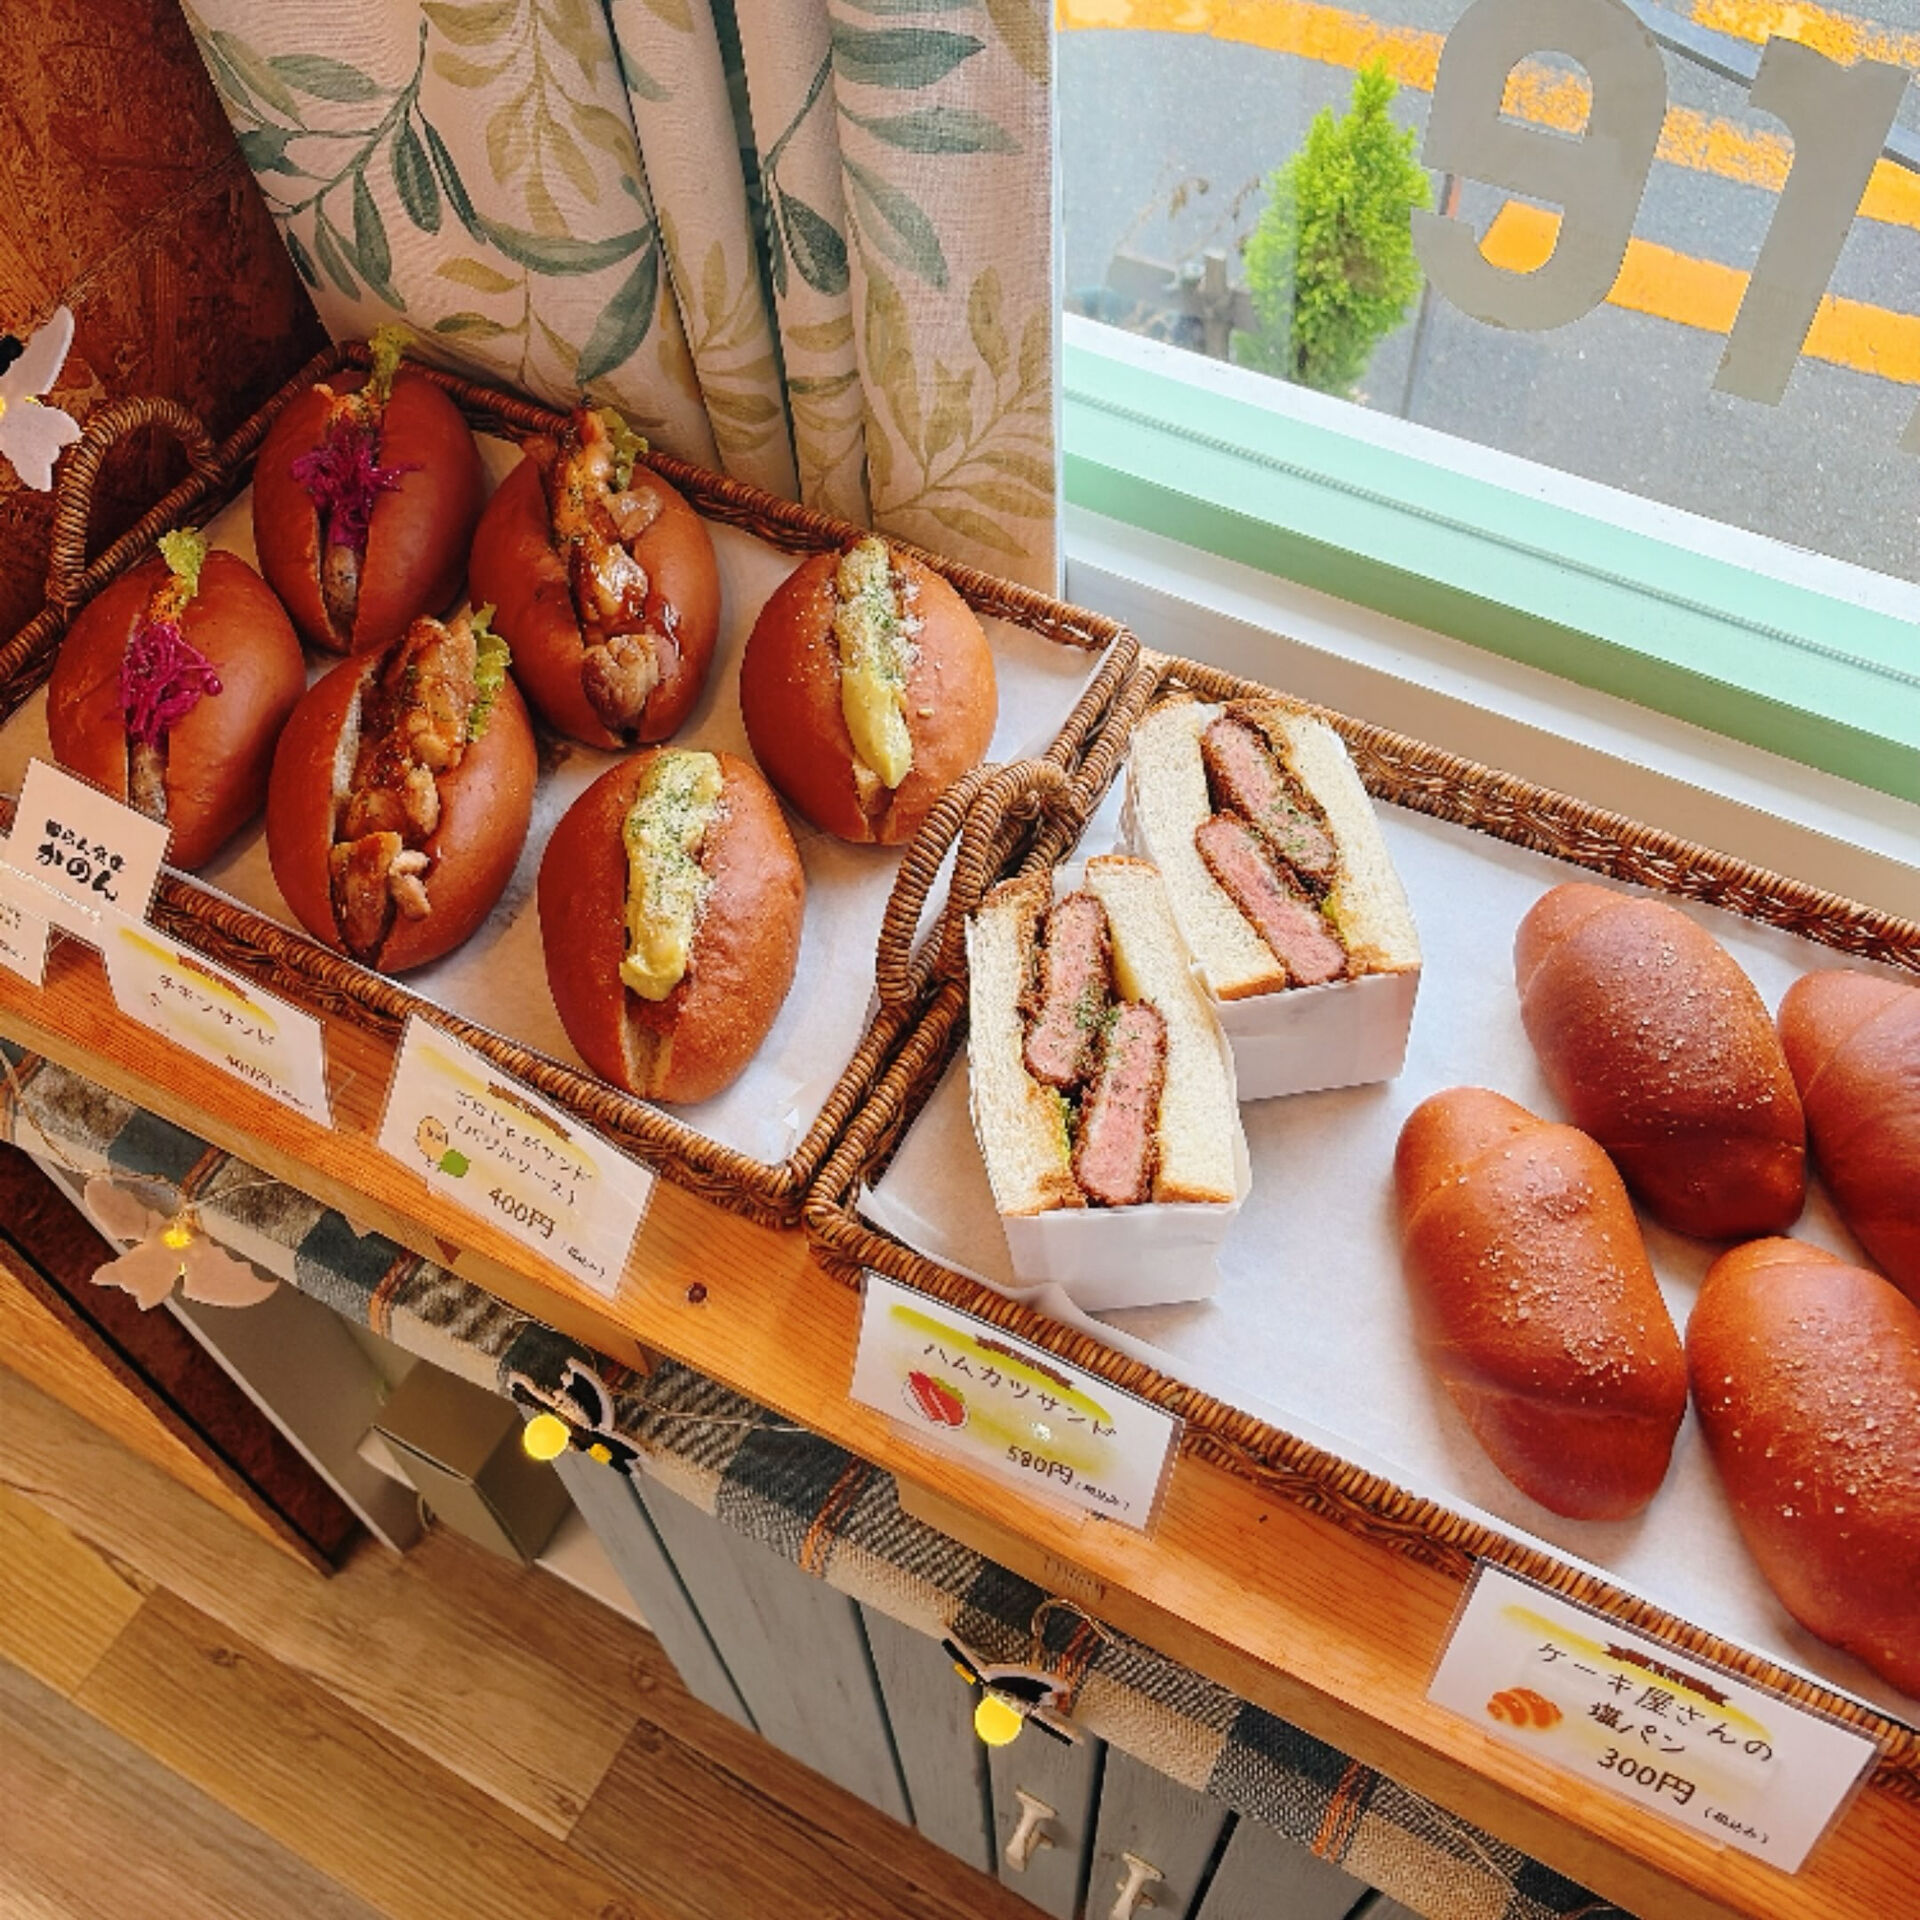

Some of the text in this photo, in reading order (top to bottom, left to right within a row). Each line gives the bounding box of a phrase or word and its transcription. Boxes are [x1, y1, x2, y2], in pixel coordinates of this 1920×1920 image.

[36, 841, 118, 902] かのん
[488, 1186, 557, 1240] 400円
[922, 1343, 1118, 1437] ハムカツサンド
[1006, 1445, 1075, 1486] 580円
[1537, 1642, 1774, 1763] ケーキ屋さんの
[1586, 1700, 1686, 1756] 塩パン
[1596, 1747, 1697, 1806] 300円
